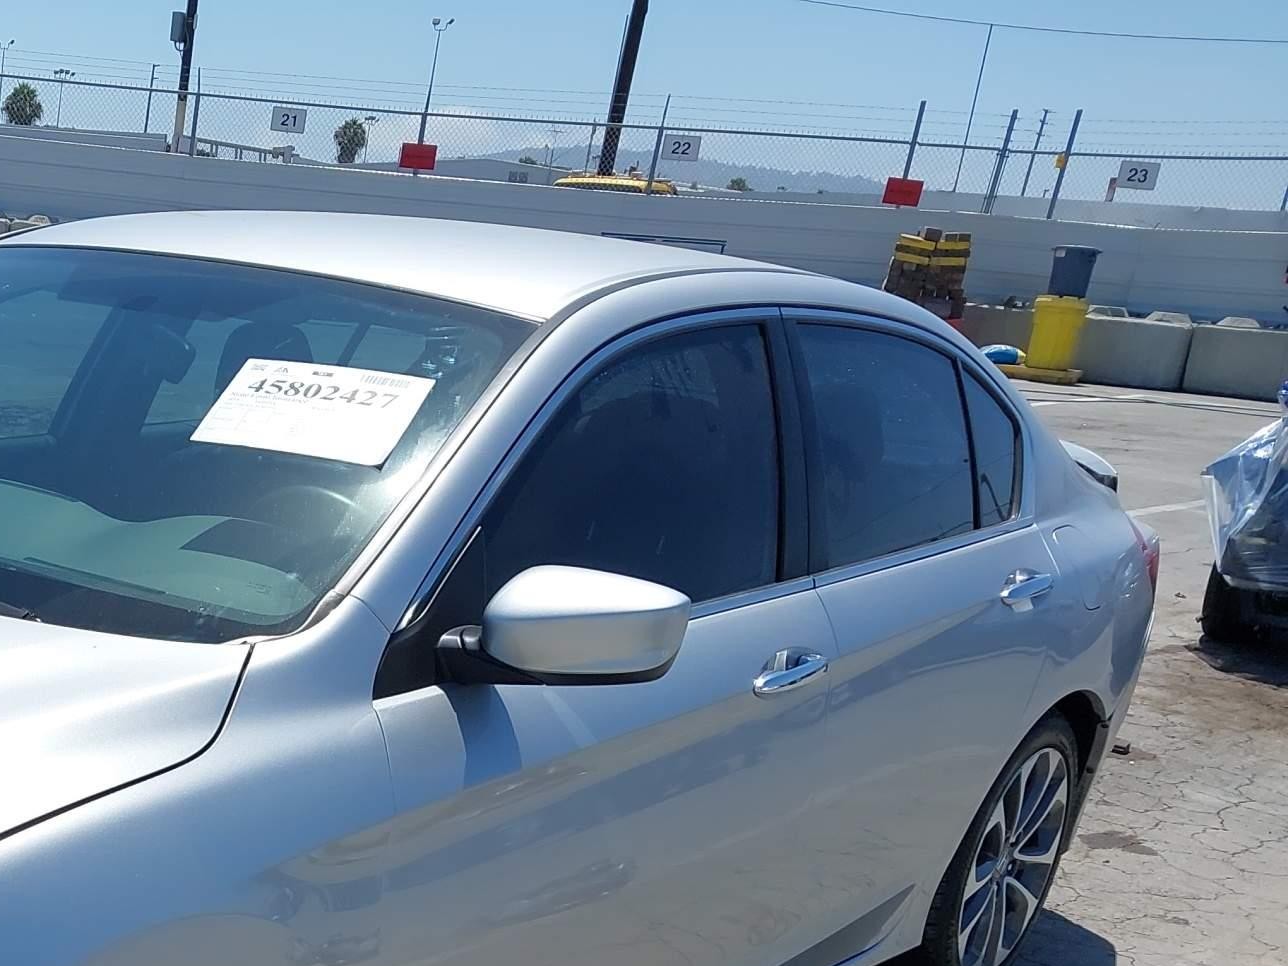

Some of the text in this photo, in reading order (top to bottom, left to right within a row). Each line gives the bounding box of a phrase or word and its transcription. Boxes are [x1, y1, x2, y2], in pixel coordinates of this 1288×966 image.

[280, 113, 297, 128] 21
[671, 141, 691, 155] 22
[1126, 167, 1149, 183] 23
[247, 377, 400, 409] 45802427
